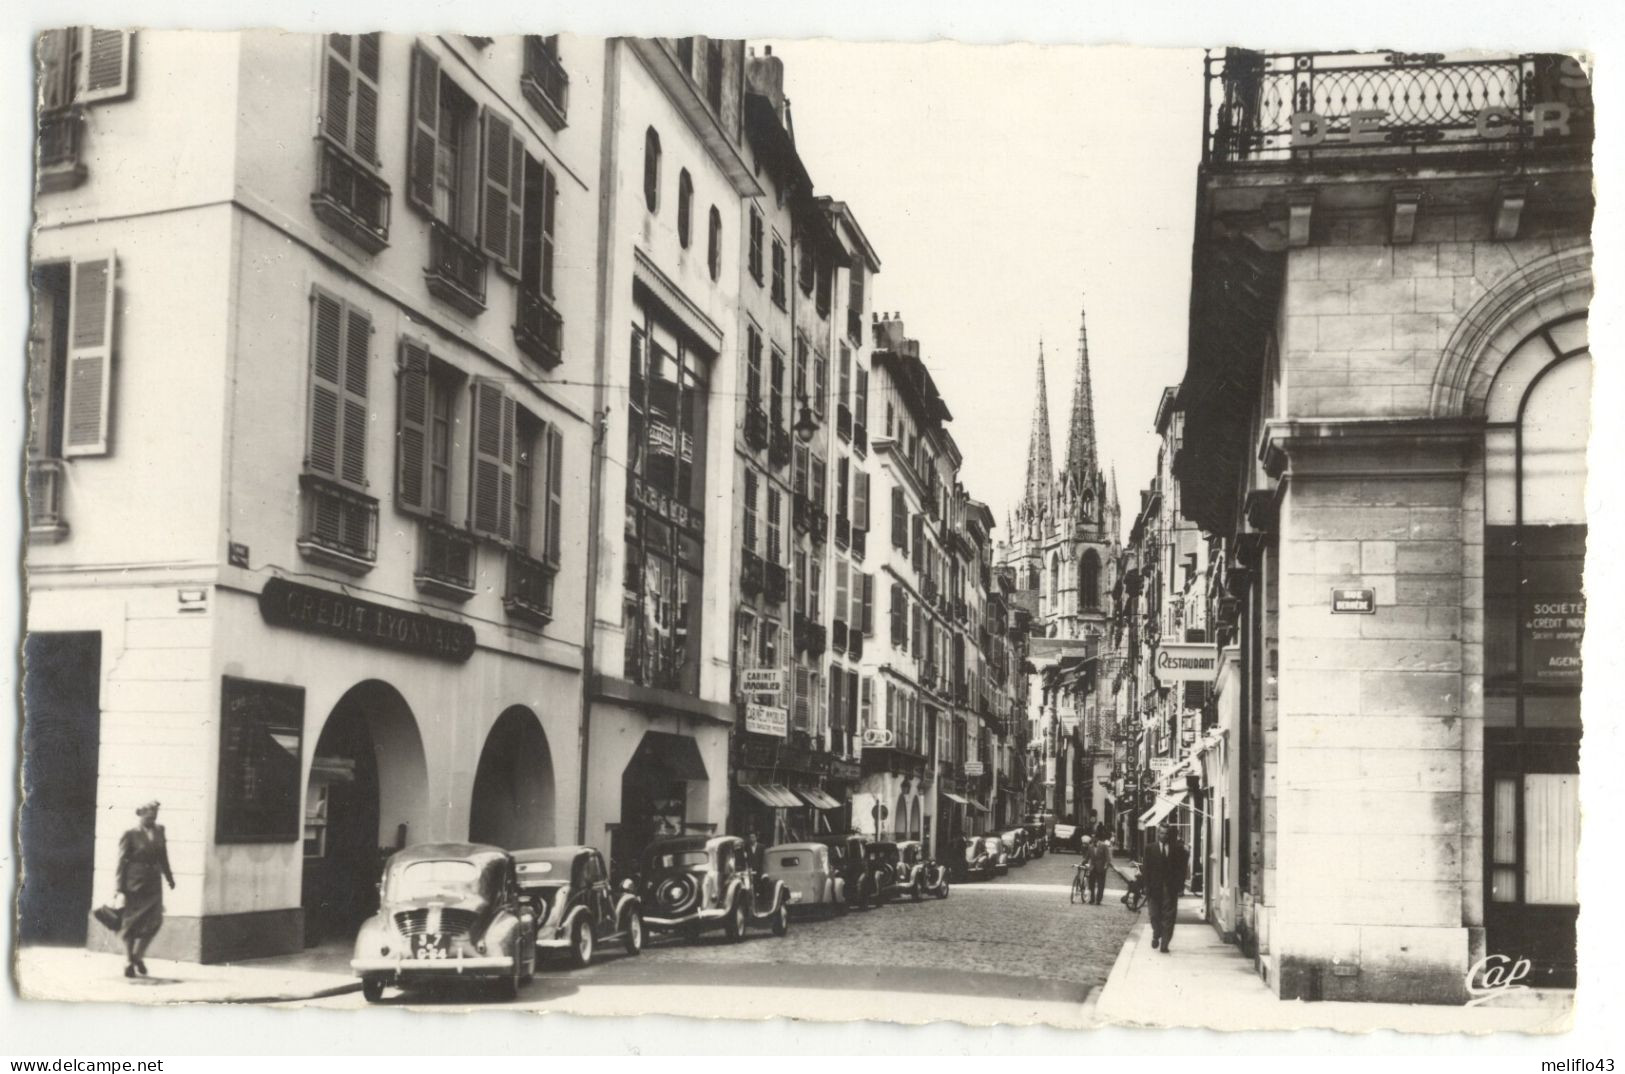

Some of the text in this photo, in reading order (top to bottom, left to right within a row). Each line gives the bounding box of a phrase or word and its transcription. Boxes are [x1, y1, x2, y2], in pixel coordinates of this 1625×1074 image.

[1291, 102, 1571, 146] DE CR
[1533, 601, 1585, 614] SOCIÉTÉ
[747, 672, 776, 681] CABINET
